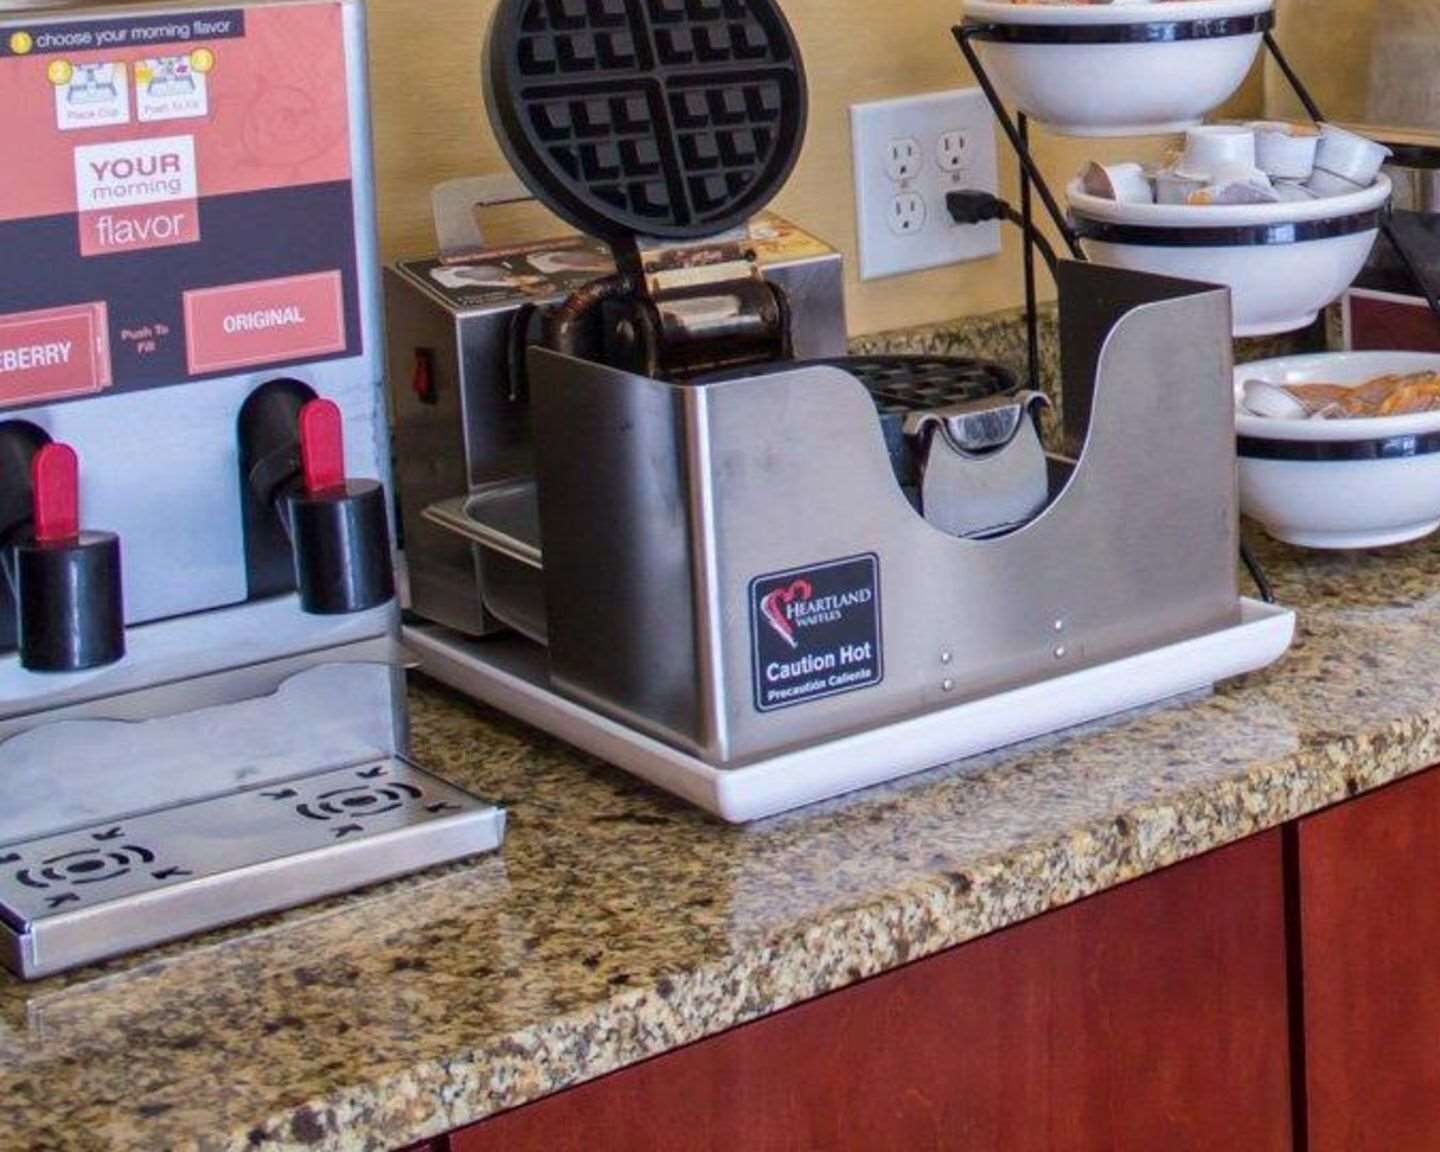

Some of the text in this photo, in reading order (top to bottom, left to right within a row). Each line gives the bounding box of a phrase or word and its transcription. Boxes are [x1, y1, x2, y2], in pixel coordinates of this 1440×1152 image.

[36, 19, 231, 48] choose your morning flavor
[90, 154, 181, 181] YOUR
[92, 178, 182, 200] morning
[96, 213, 184, 246] flavor
[121, 326, 153, 341] Push
[223, 305, 305, 334] ORIGINAL
[0, 341, 72, 372] BERRY
[786, 588, 872, 620] HEARTLAND
[795, 609, 843, 627] WAFFLES
[766, 642, 872, 682] Caution Hot
[828, 668, 872, 687] Caliente
